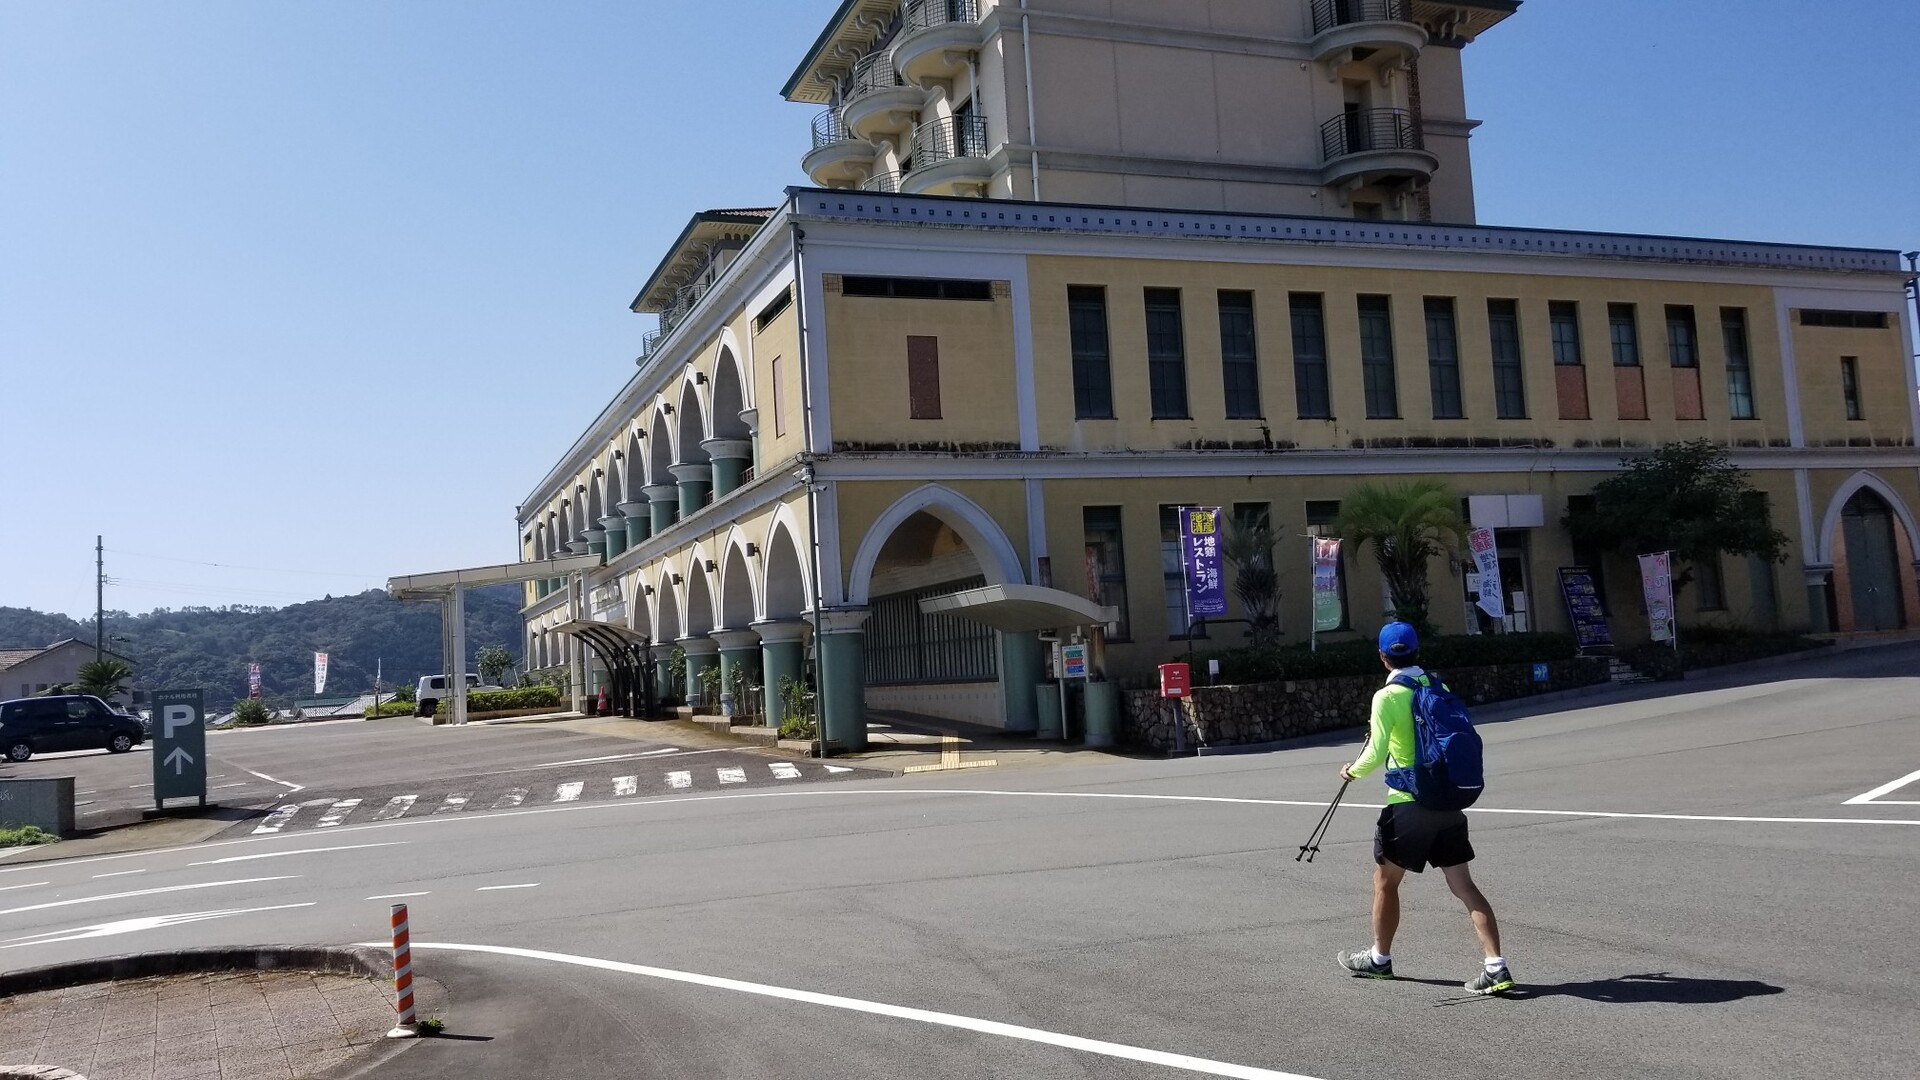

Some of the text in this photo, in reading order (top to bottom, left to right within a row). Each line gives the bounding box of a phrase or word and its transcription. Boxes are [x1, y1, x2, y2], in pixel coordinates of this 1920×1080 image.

[1193, 537, 1208, 593] レストラン
[163, 704, 196, 739] P
